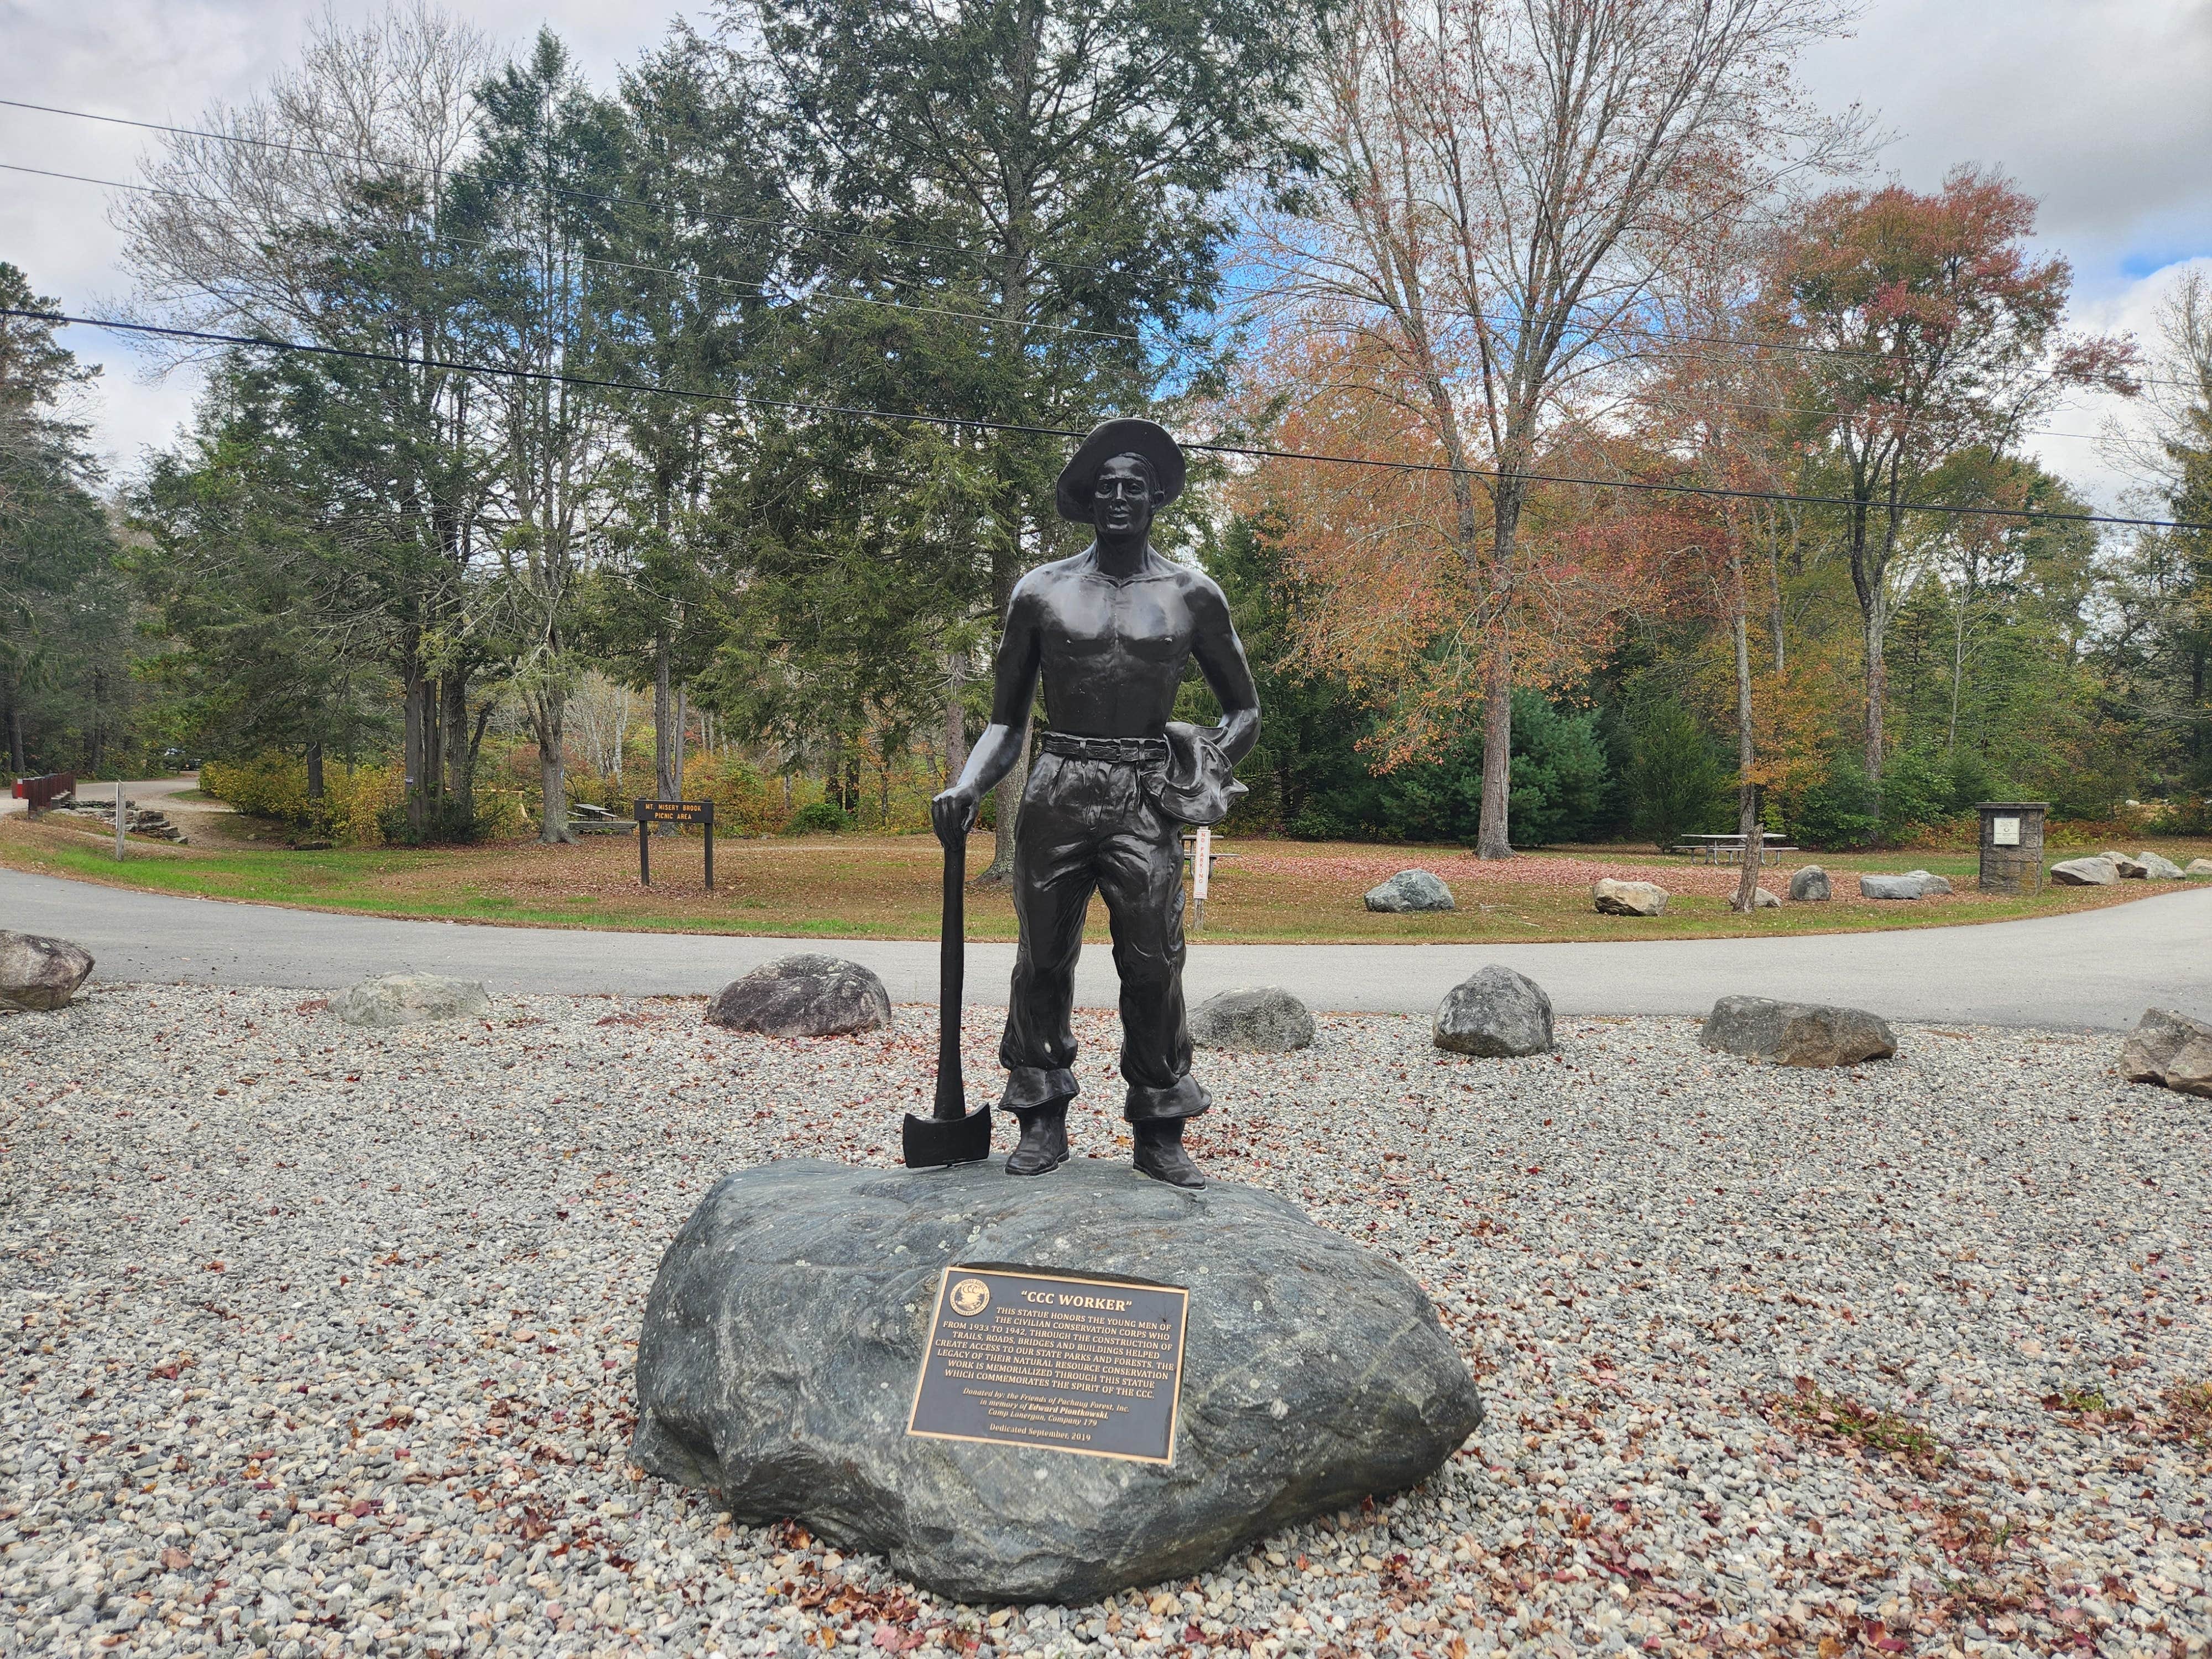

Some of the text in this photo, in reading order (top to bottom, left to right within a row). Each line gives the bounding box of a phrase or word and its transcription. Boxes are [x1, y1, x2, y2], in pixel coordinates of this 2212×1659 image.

[1201, 833, 1206, 843] NO
[995, 1316, 1170, 1341] THE CIVILIAN CONSERVATION CORPS WHO
[996, 1307, 1016, 1315] THIS
[1018, 1309, 1049, 1318] STATUE
[1051, 1312, 1086, 1322] HONORS
[1088, 1316, 1105, 1324] THE
[1107, 1318, 1136, 1328] YOUNG
[1138, 1321, 1157, 1330] MEN
[943, 1321, 967, 1329] FROM
[969, 1323, 989, 1332] 1933
[1030, 1329, 1071, 1340] THROUGH
[1073, 1334, 1091, 1342] THE
[1093, 1336, 1159, 1349] CONSTRUCTION
[952, 1331, 1160, 1359] TRAILS, ROADS, BRIDGES AND BUILDINGS HELPED
[935, 1339, 968, 1349] CREATE
[969, 1343, 1000, 1352] ACCESS
[1036, 1349, 1062, 1359] STATE
[1064, 1352, 1091, 1361] PARKS
[1093, 1355, 1112, 1364] AND
[1156, 1362, 1175, 1371] THE
[937, 1349, 970, 1359] LEGACY
[985, 1354, 1011, 1363] THEIR
[1013, 1357, 1053, 1368] NATURAL
[1055, 1361, 1100, 1373] RESOURCE
[1102, 1366, 1168, 1380] CONSERVATION
[945, 1369, 1155, 1399] WHICH COMMEMORATES THE SPIRIT OF THE CCC.
[948, 1359, 974, 1369] WORK
[986, 1364, 1052, 1377] MEMORIALIZED
[1055, 1371, 1097, 1382] THROUGH
[1099, 1375, 1120, 1384] THIS
[1122, 1378, 1155, 1389] STATUE
[963, 1387, 994, 1397] Donated
[994, 1390, 1005, 1399] by:
[1020, 1393, 1047, 1402] Friends
[1048, 1397, 1058, 1405] of
[1057, 1397, 1088, 1408] Pachaug
[1090, 1401, 1114, 1411] Forest,
[1117, 1404, 1129, 1412] Inc.
[989, 1400, 1018, 1410] memory
[1020, 1402, 1029, 1411] of
[1028, 1403, 1058, 1413] Edward
[988, 1408, 1098, 1427] Camp Lonergan, Company 179
[989, 1423, 1092, 1442] Dedicated September, 2019
